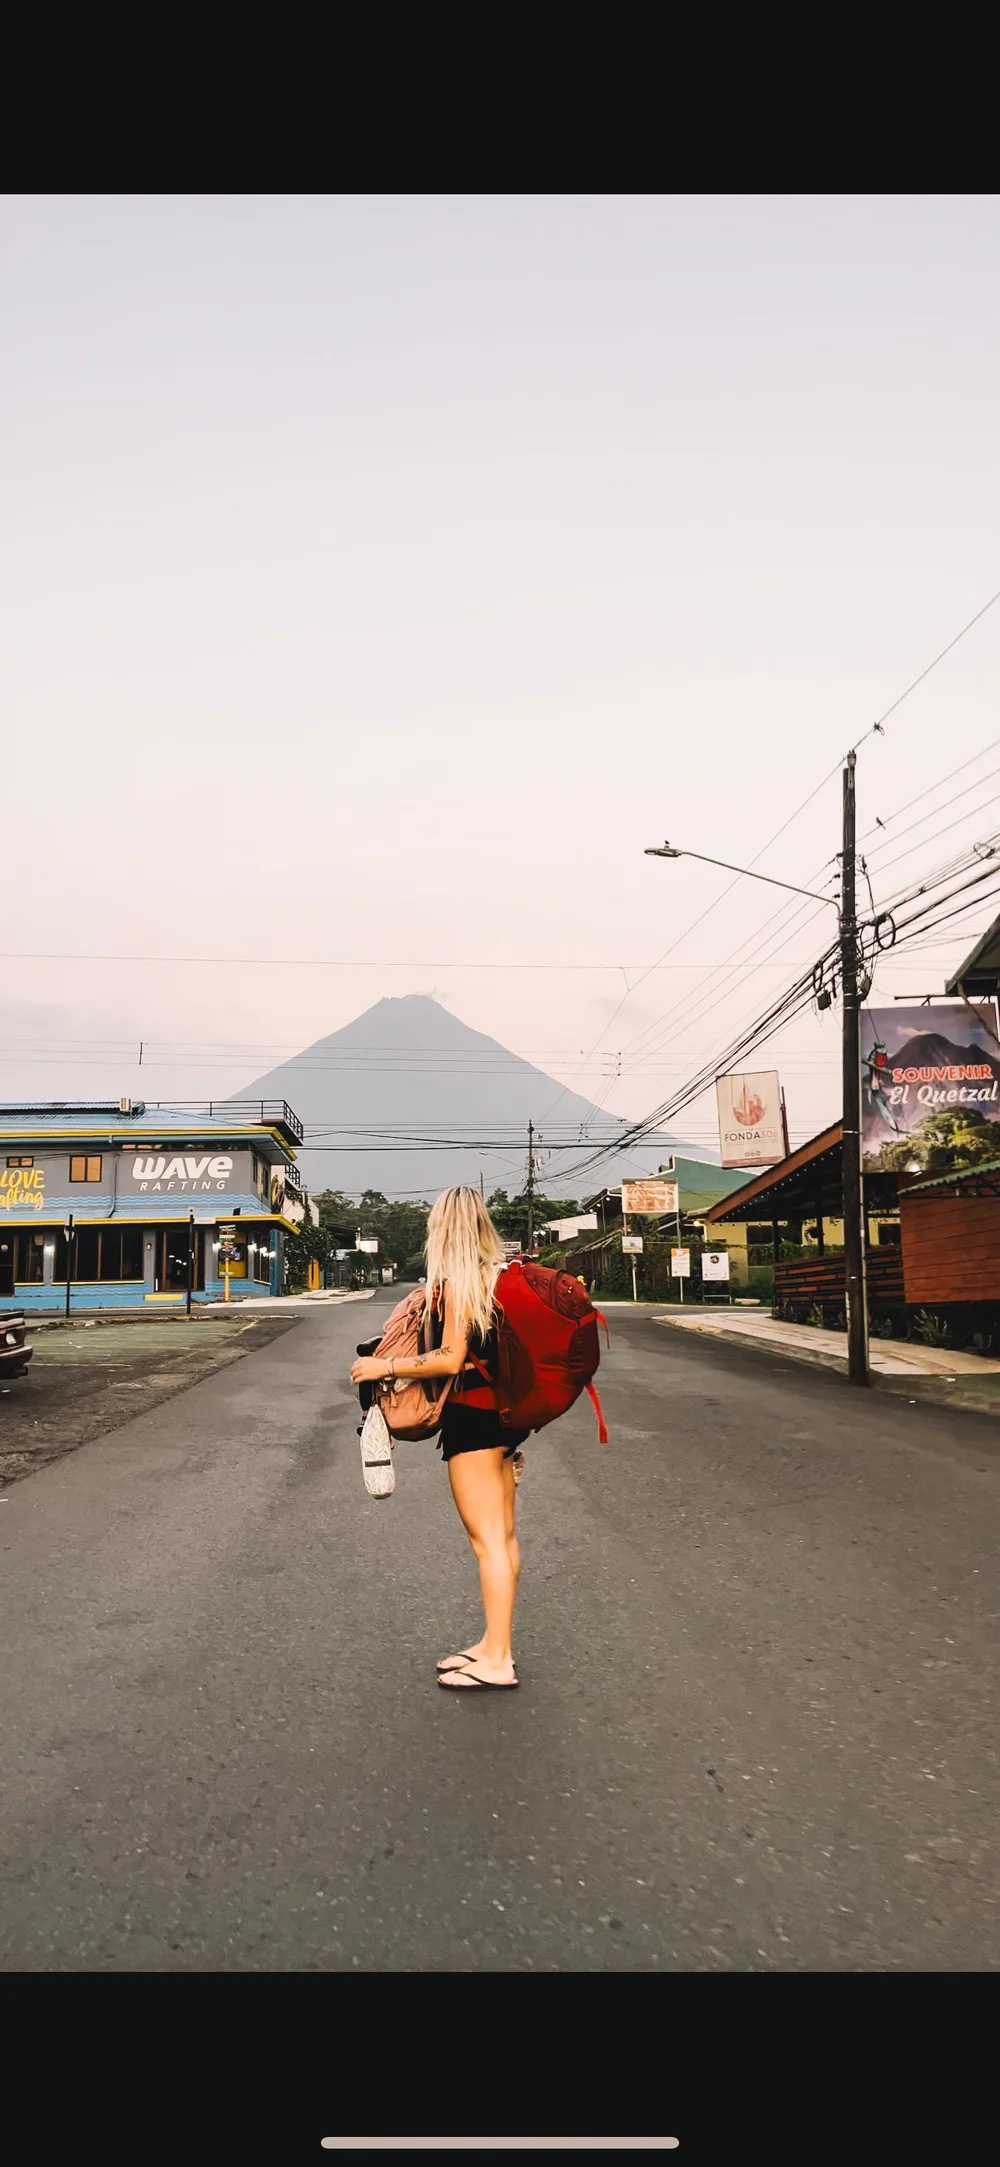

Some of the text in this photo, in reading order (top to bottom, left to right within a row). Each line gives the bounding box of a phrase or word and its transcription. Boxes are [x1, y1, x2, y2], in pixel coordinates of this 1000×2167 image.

[892, 1064, 994, 1083] SOUVENIR
[889, 1080, 998, 1106] El Quetzal
[0, 1169, 45, 1189] LOVE
[140, 1180, 226, 1191] RAFTING
